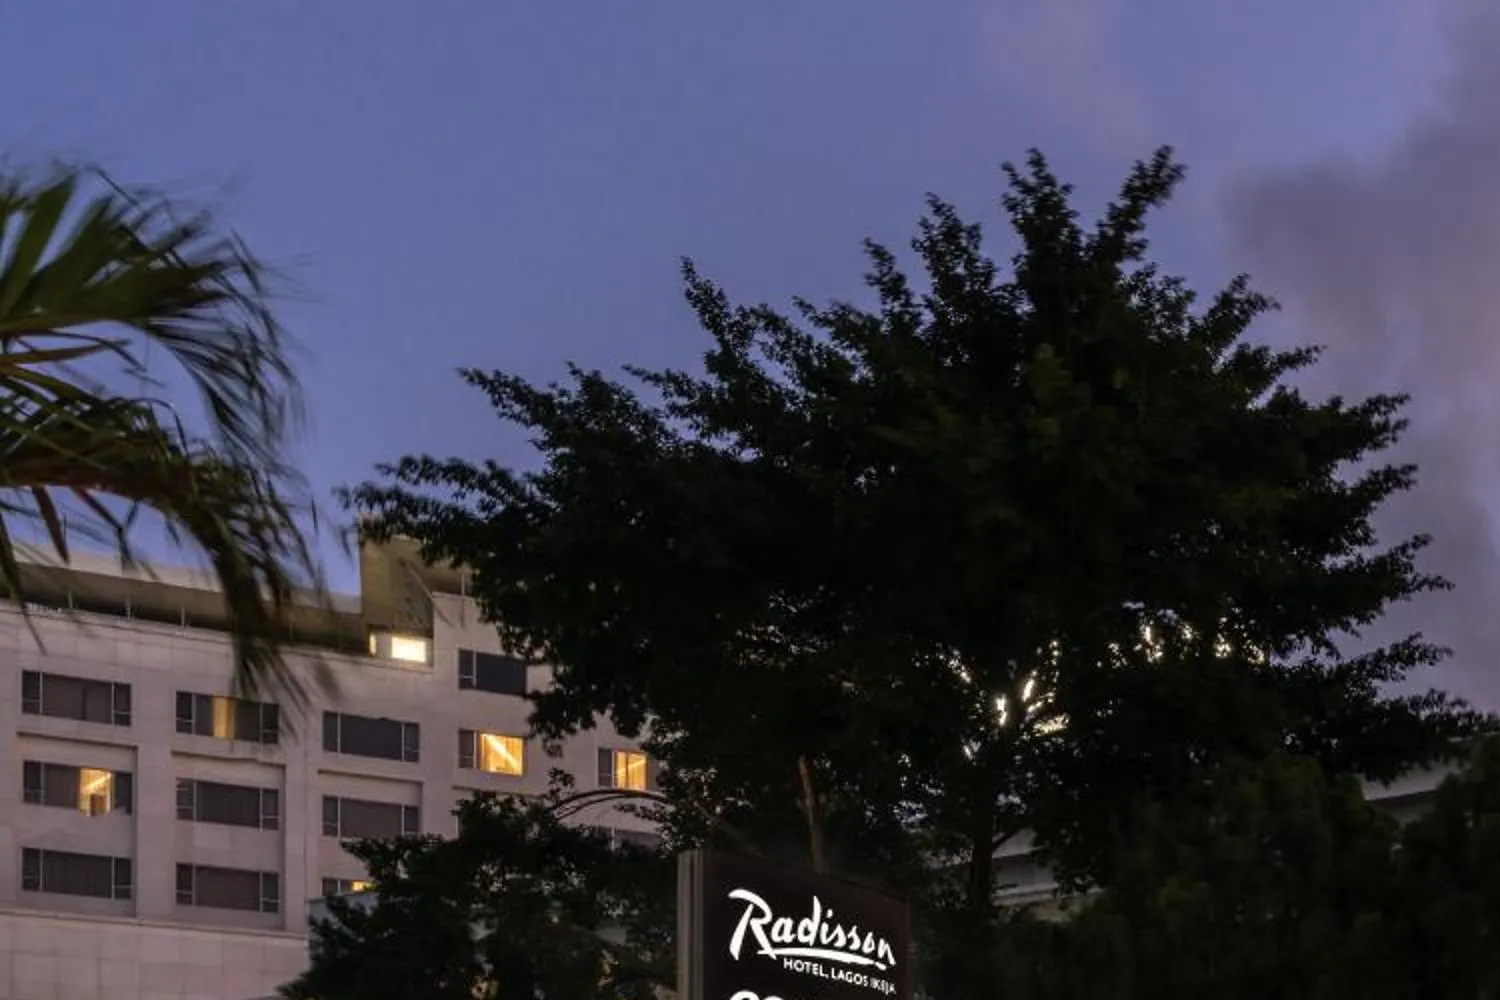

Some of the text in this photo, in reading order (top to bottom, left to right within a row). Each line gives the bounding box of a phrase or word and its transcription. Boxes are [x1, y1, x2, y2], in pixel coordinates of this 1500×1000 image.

[728, 888, 896, 968] Radisson
[783, 957, 829, 979] HOTEL,
[831, 967, 869, 987] LAGOS
